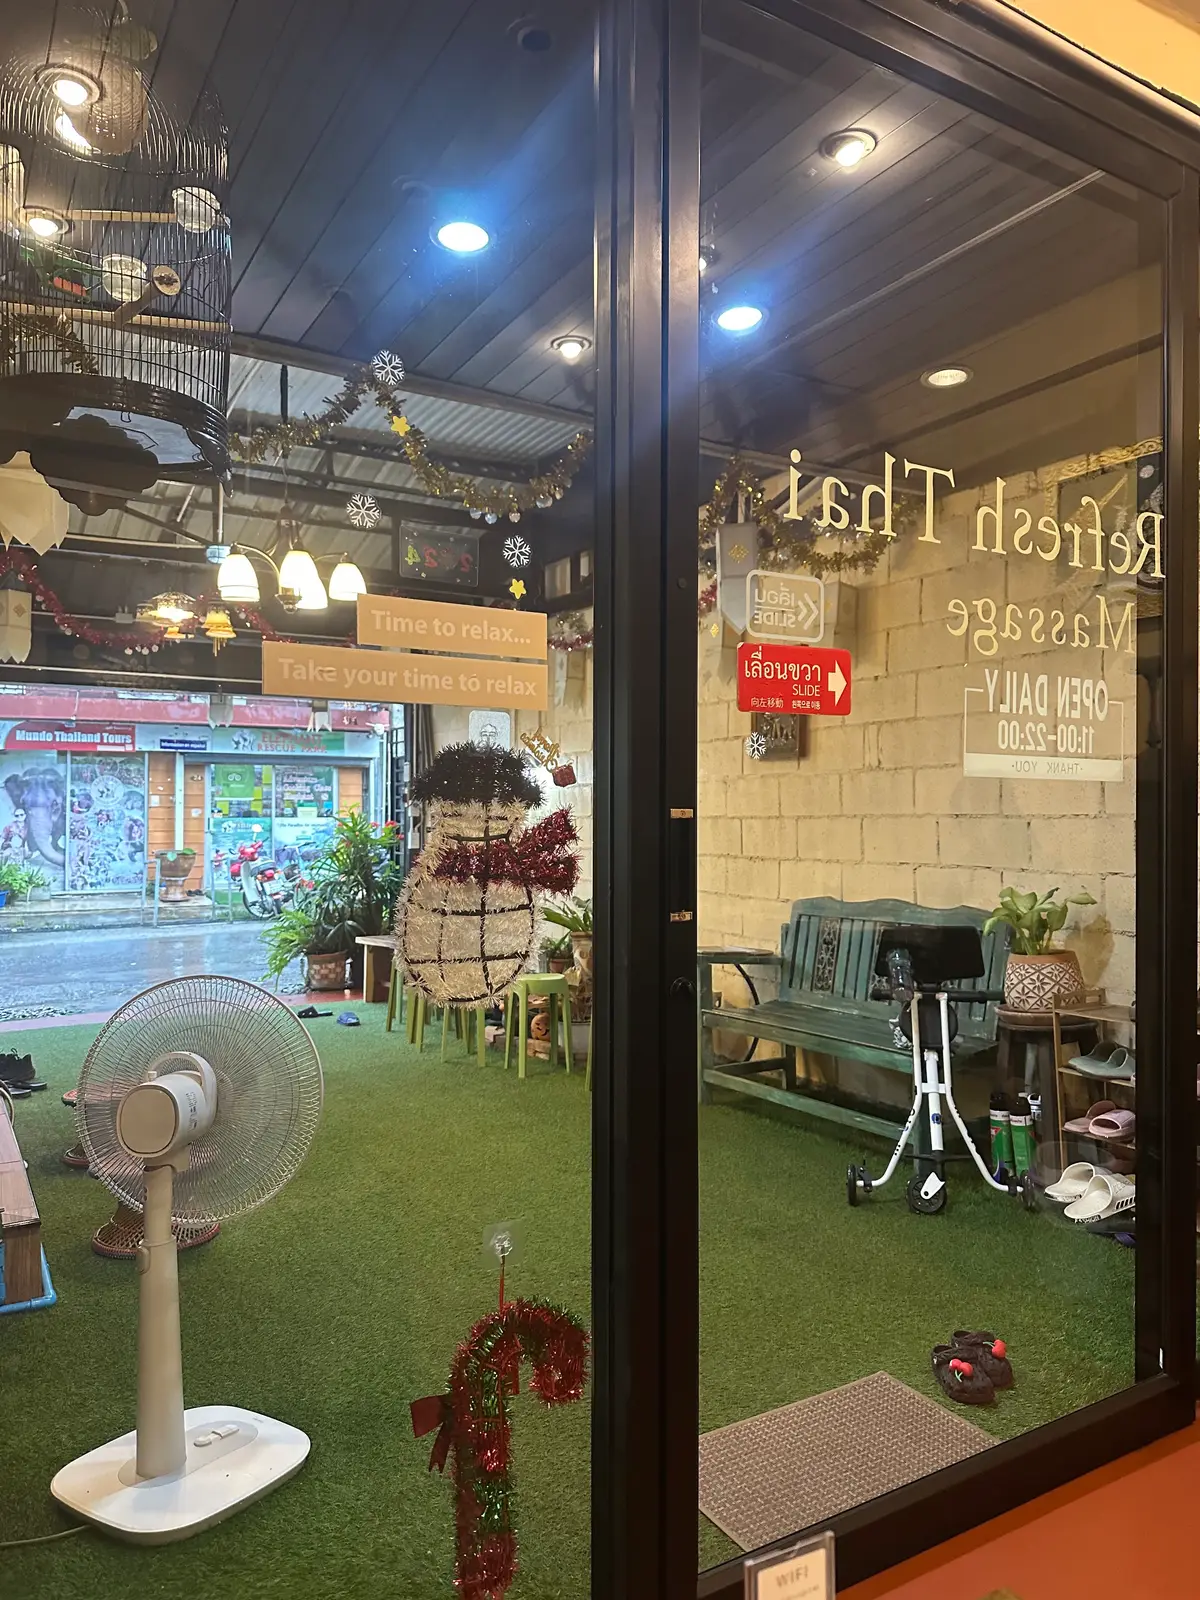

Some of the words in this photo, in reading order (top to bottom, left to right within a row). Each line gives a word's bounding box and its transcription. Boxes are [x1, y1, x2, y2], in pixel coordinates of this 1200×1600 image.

[371, 609, 428, 633] Time
[433, 620, 455, 637] to
[461, 621, 531, 644] relax...
[278, 658, 338, 682] Take
[343, 668, 398, 688] your
[403, 668, 453, 690] time
[458, 674, 481, 692] to
[486, 675, 537, 696] relax
[744, 645, 821, 682] เลื่อนขวา
[792, 684, 820, 697] SLIDE
[16, 730, 53, 741] Mundo
[54, 731, 100, 743] Thailand
[102, 733, 132, 743] Tours
[776, 1564, 809, 1588] WIFI
